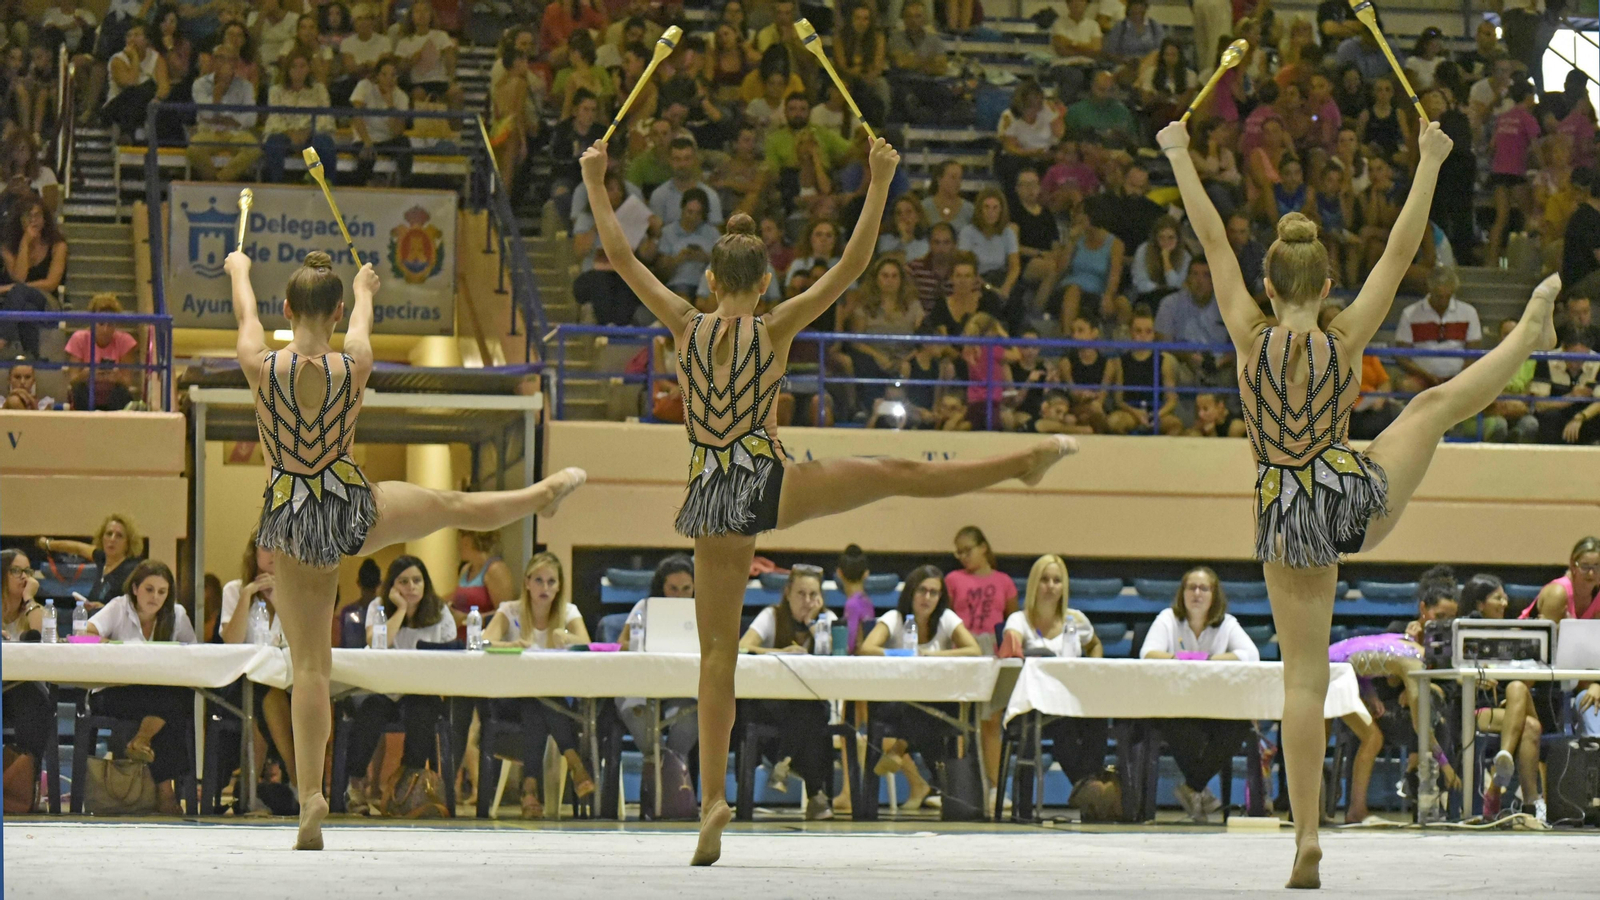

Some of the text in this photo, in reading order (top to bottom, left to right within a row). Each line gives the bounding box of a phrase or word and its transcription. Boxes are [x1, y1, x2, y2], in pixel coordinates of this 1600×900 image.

[249, 212, 376, 240] Delegación
[244, 241, 380, 266] de Deortes
[373, 301, 442, 323] geciras
